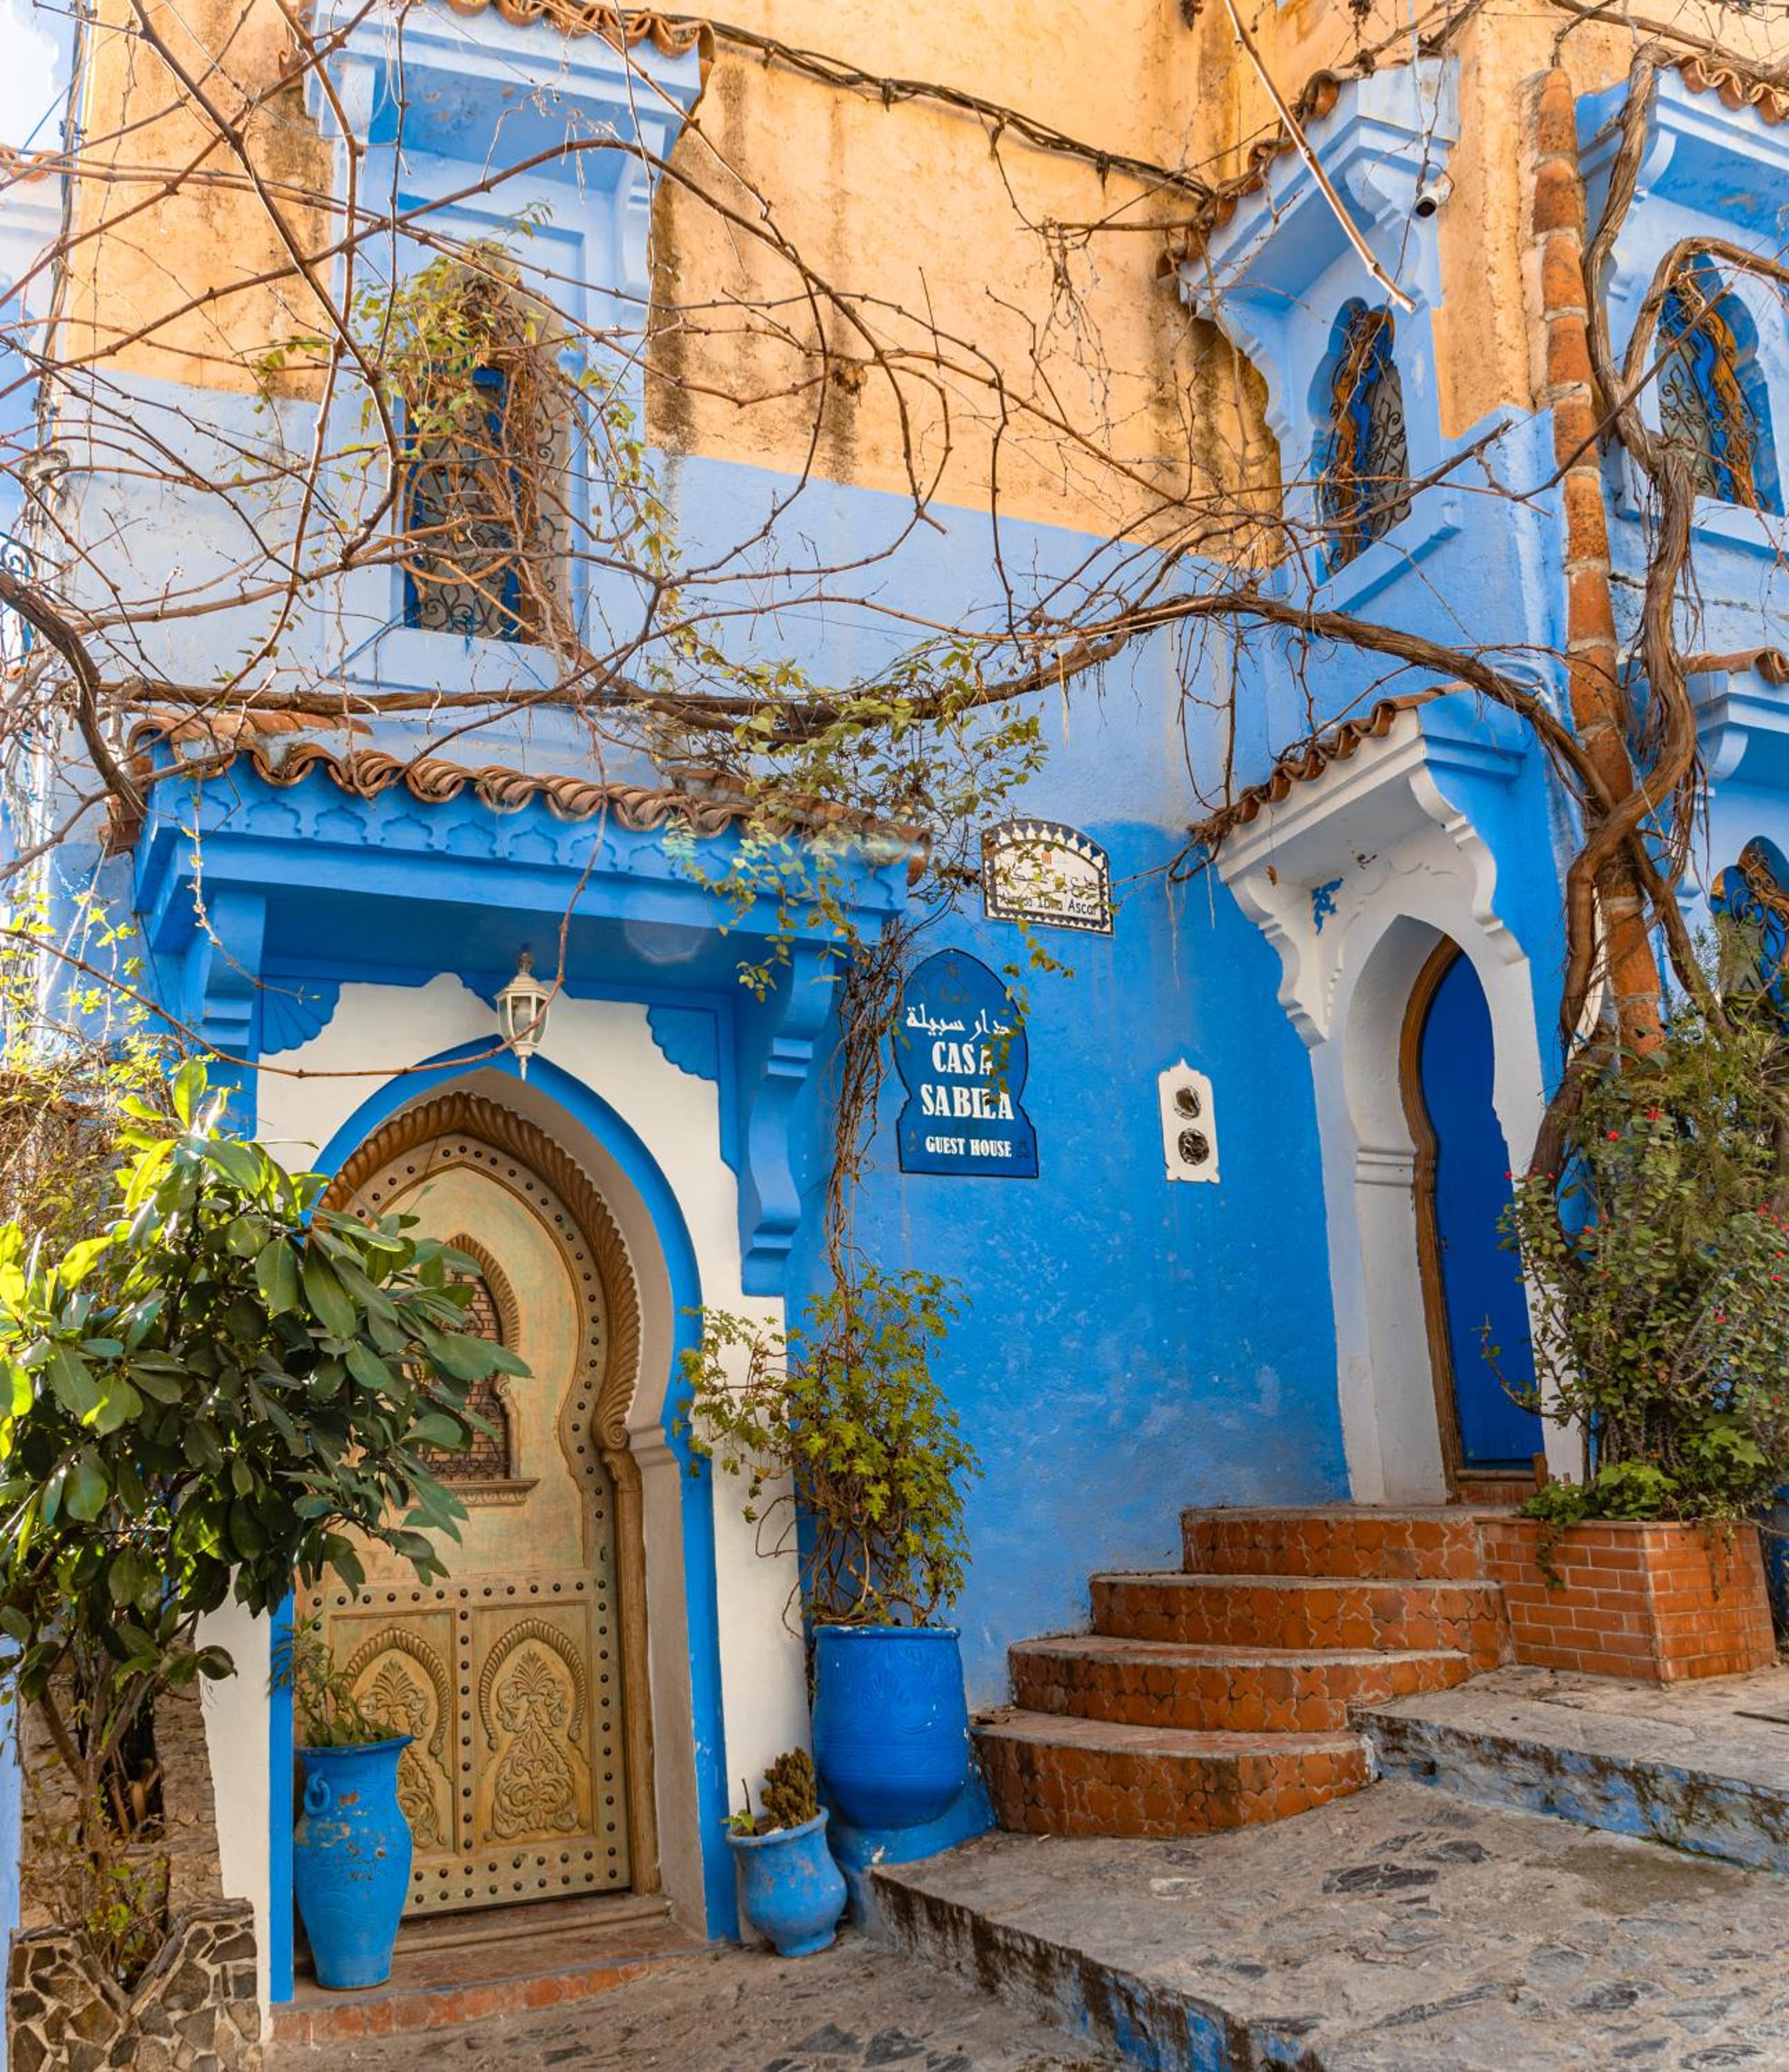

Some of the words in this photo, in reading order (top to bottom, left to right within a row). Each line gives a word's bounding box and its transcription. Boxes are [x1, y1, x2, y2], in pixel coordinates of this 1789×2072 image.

[906, 1003, 966, 1037] سبيلة
[932, 1041, 995, 1075] CASA
[920, 1082, 1015, 1120] SABILA
[925, 1136, 966, 1155] GUEST
[970, 1139, 1013, 1158] HOUSE
